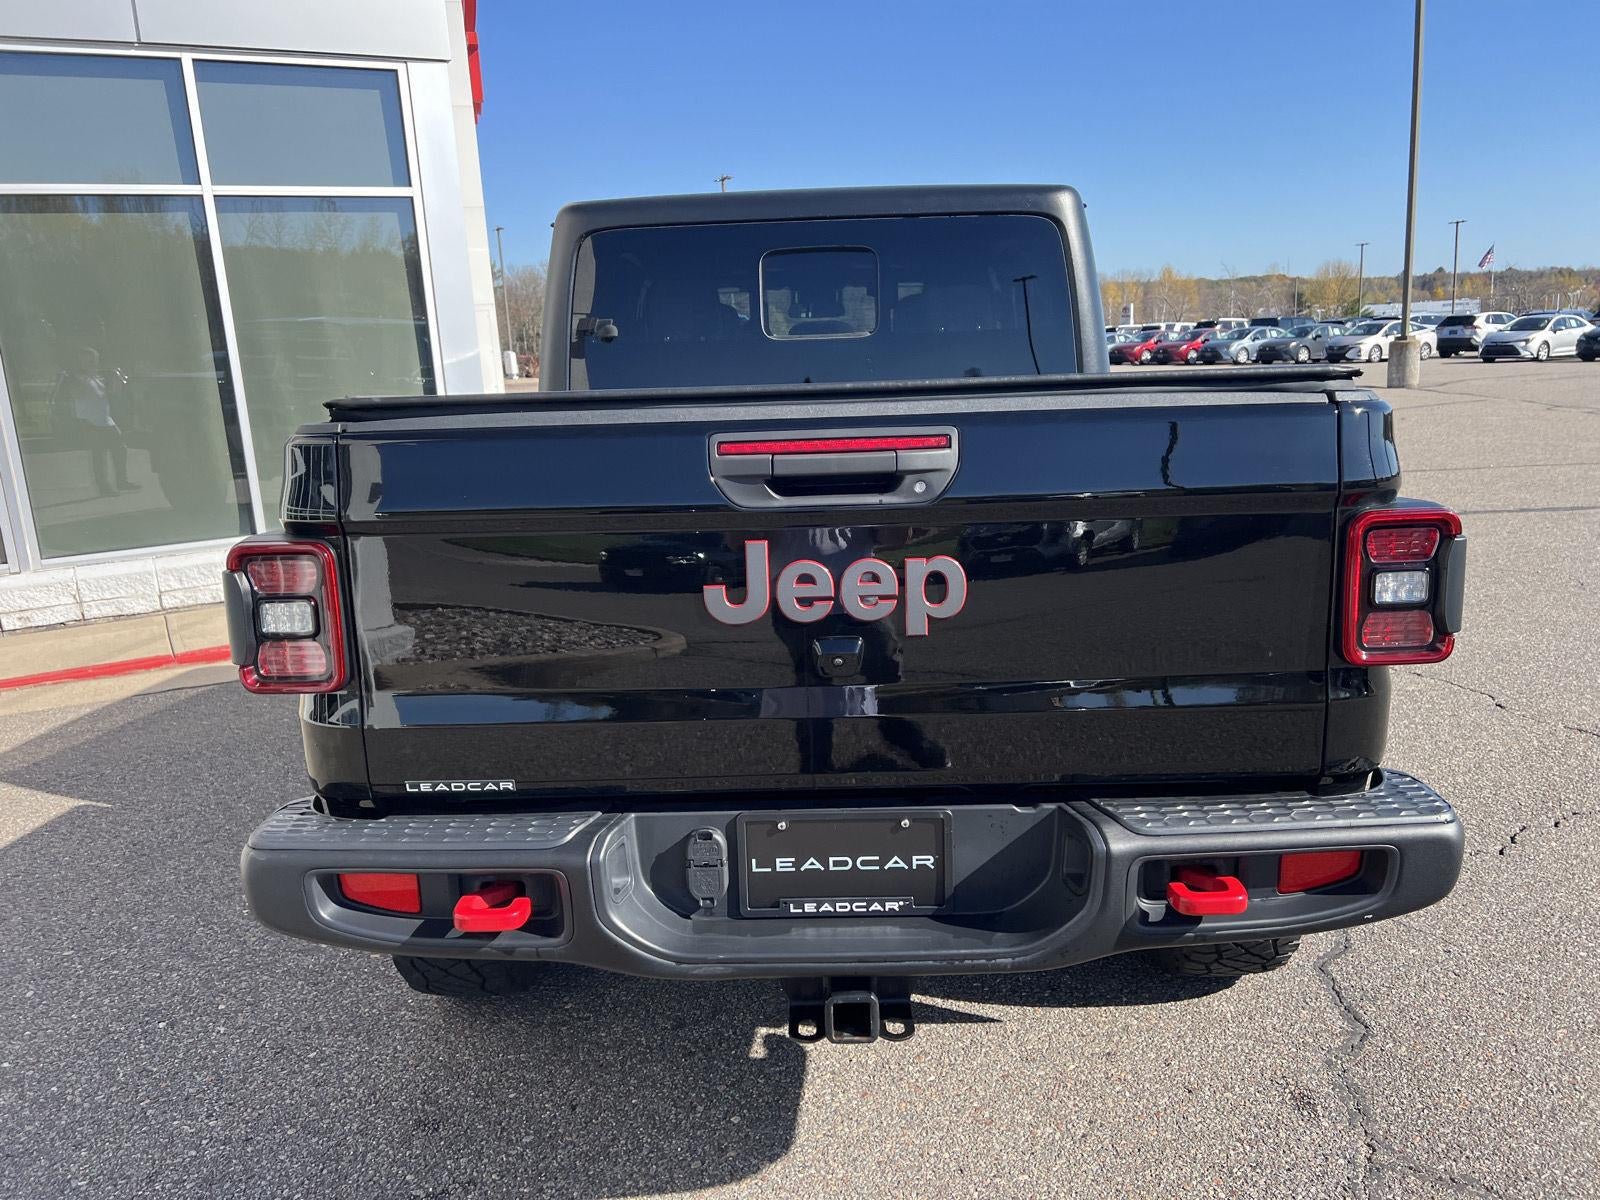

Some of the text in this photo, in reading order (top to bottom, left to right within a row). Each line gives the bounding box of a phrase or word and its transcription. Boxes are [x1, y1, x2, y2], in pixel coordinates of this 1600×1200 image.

[703, 539, 968, 636] Jeep
[405, 782, 515, 792] LEADCAR
[751, 855, 935, 872] LEADCAR
[789, 901, 901, 912] LEADCAR
